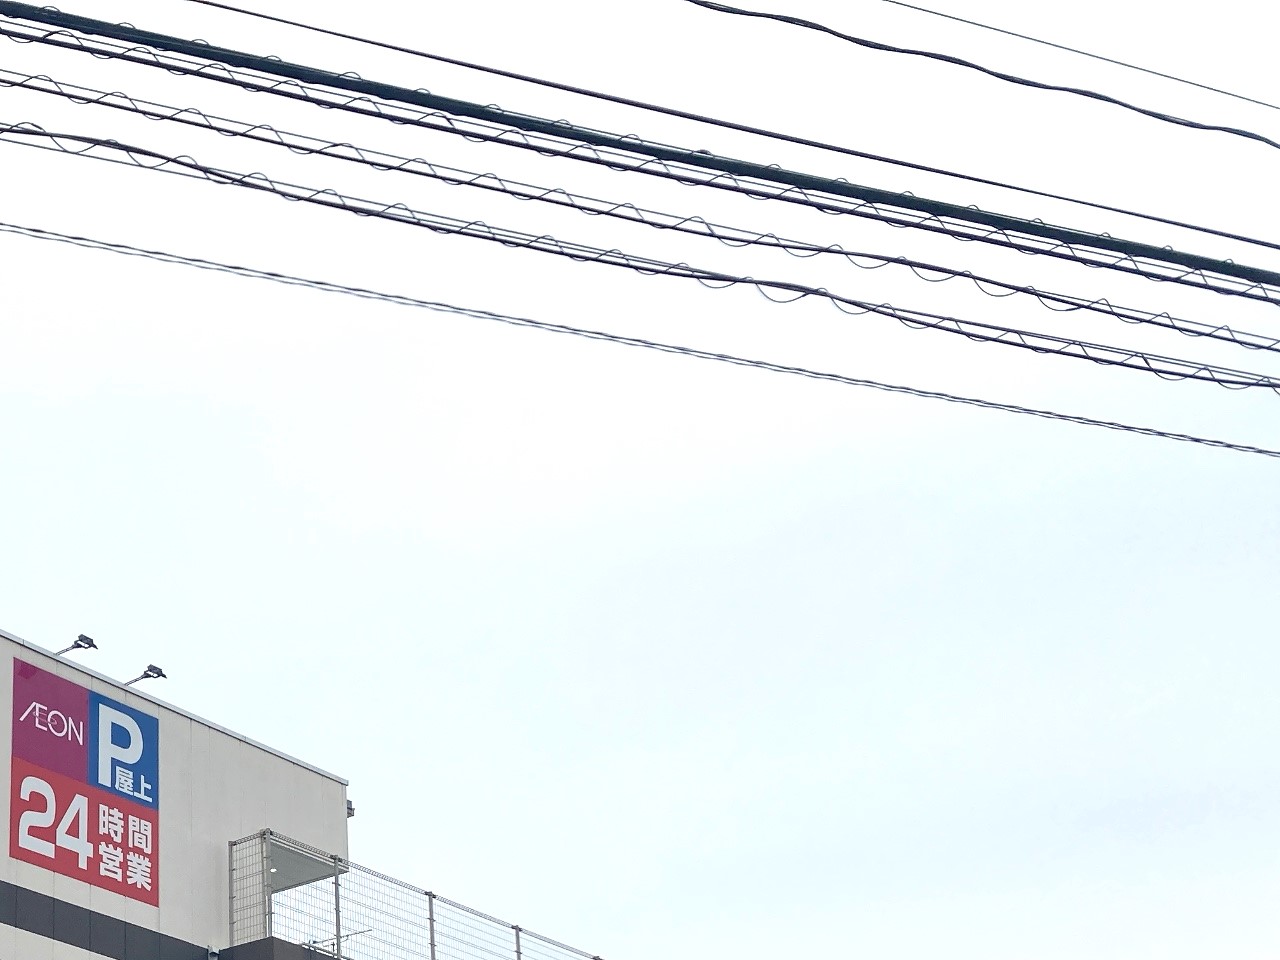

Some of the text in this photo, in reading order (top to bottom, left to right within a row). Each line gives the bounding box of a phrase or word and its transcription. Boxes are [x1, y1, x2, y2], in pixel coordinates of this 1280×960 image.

[97, 703, 144, 788] P
[114, 765, 153, 803] 屋上
[19, 775, 94, 870] 24
[98, 803, 153, 854] 時間
[98, 843, 153, 892] 営業
